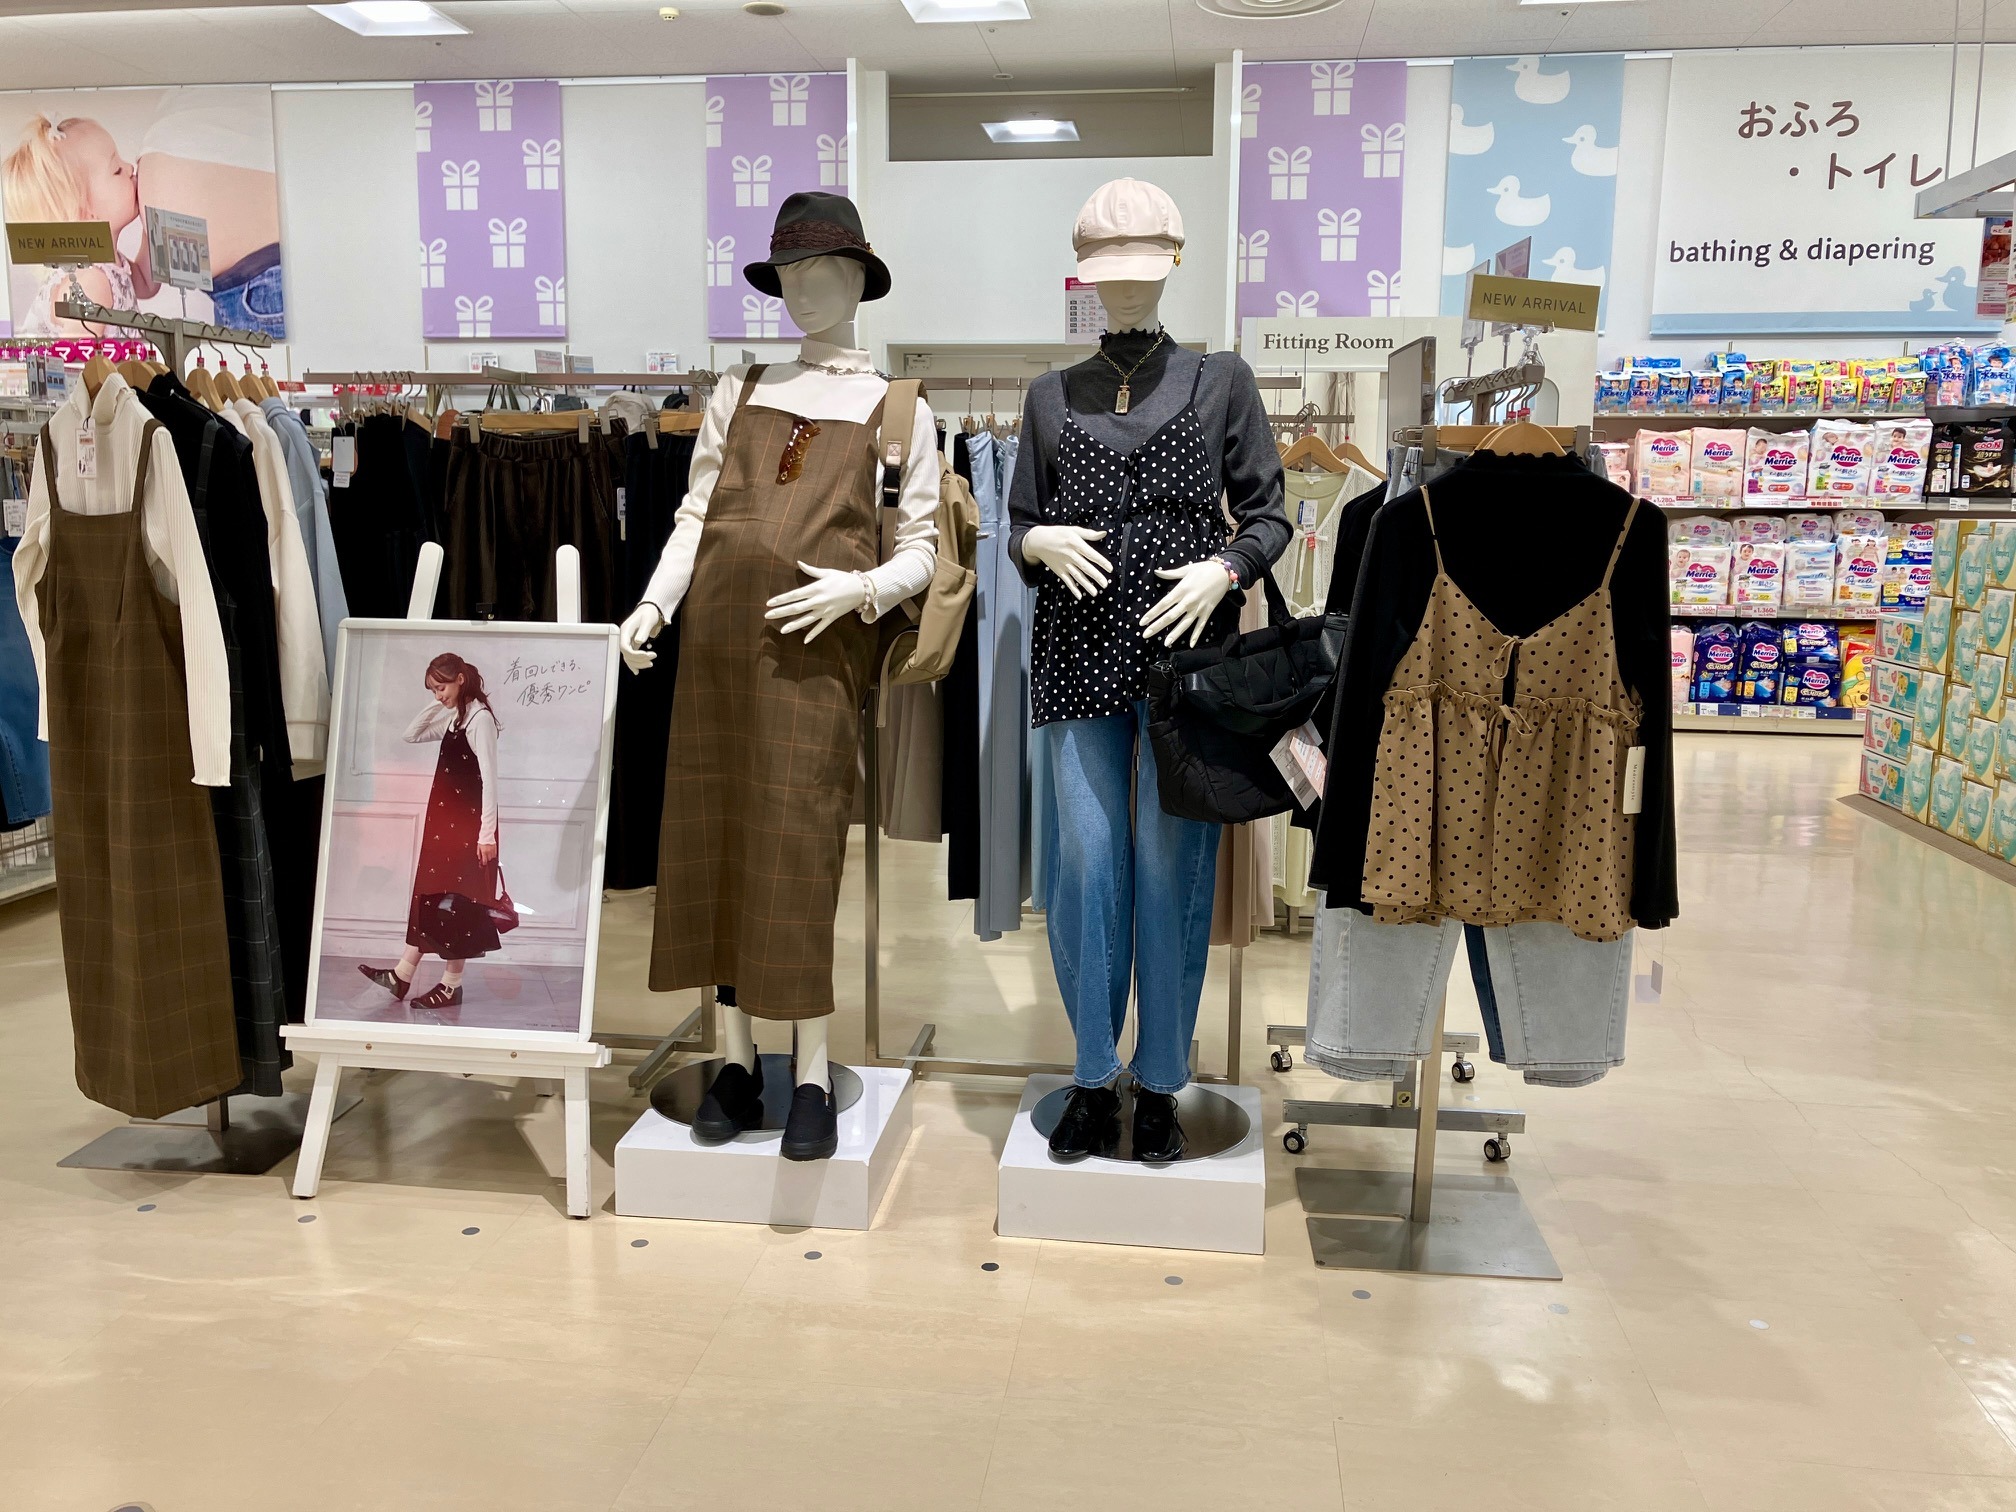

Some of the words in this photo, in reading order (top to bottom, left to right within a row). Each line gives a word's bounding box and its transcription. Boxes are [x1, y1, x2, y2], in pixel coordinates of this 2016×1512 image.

[1738, 101, 1860, 138] おふろ
[18, 238, 46, 249] NEW
[51, 237, 104, 248] ARRIVAL
[1670, 239, 1772, 267] bathing
[1779, 238, 1798, 260] &
[1807, 236, 1936, 266] diapering
[1483, 292, 1517, 306] NEW
[1522, 297, 1586, 314] ARRIVAL
[1263, 333, 1330, 354] Fitting
[1335, 333, 1394, 349] Room
[1651, 444, 1679, 452] Merries
[1704, 448, 1733, 457] Merries
[1765, 456, 1797, 466] Merries
[1831, 452, 1863, 463] Merries
[1887, 455, 1921, 465] Merries
[1848, 564, 1878, 573] Merries
[1707, 650, 1734, 658] Merries
[1752, 649, 1779, 657] Merries
[1803, 676, 1830, 684] Merries
